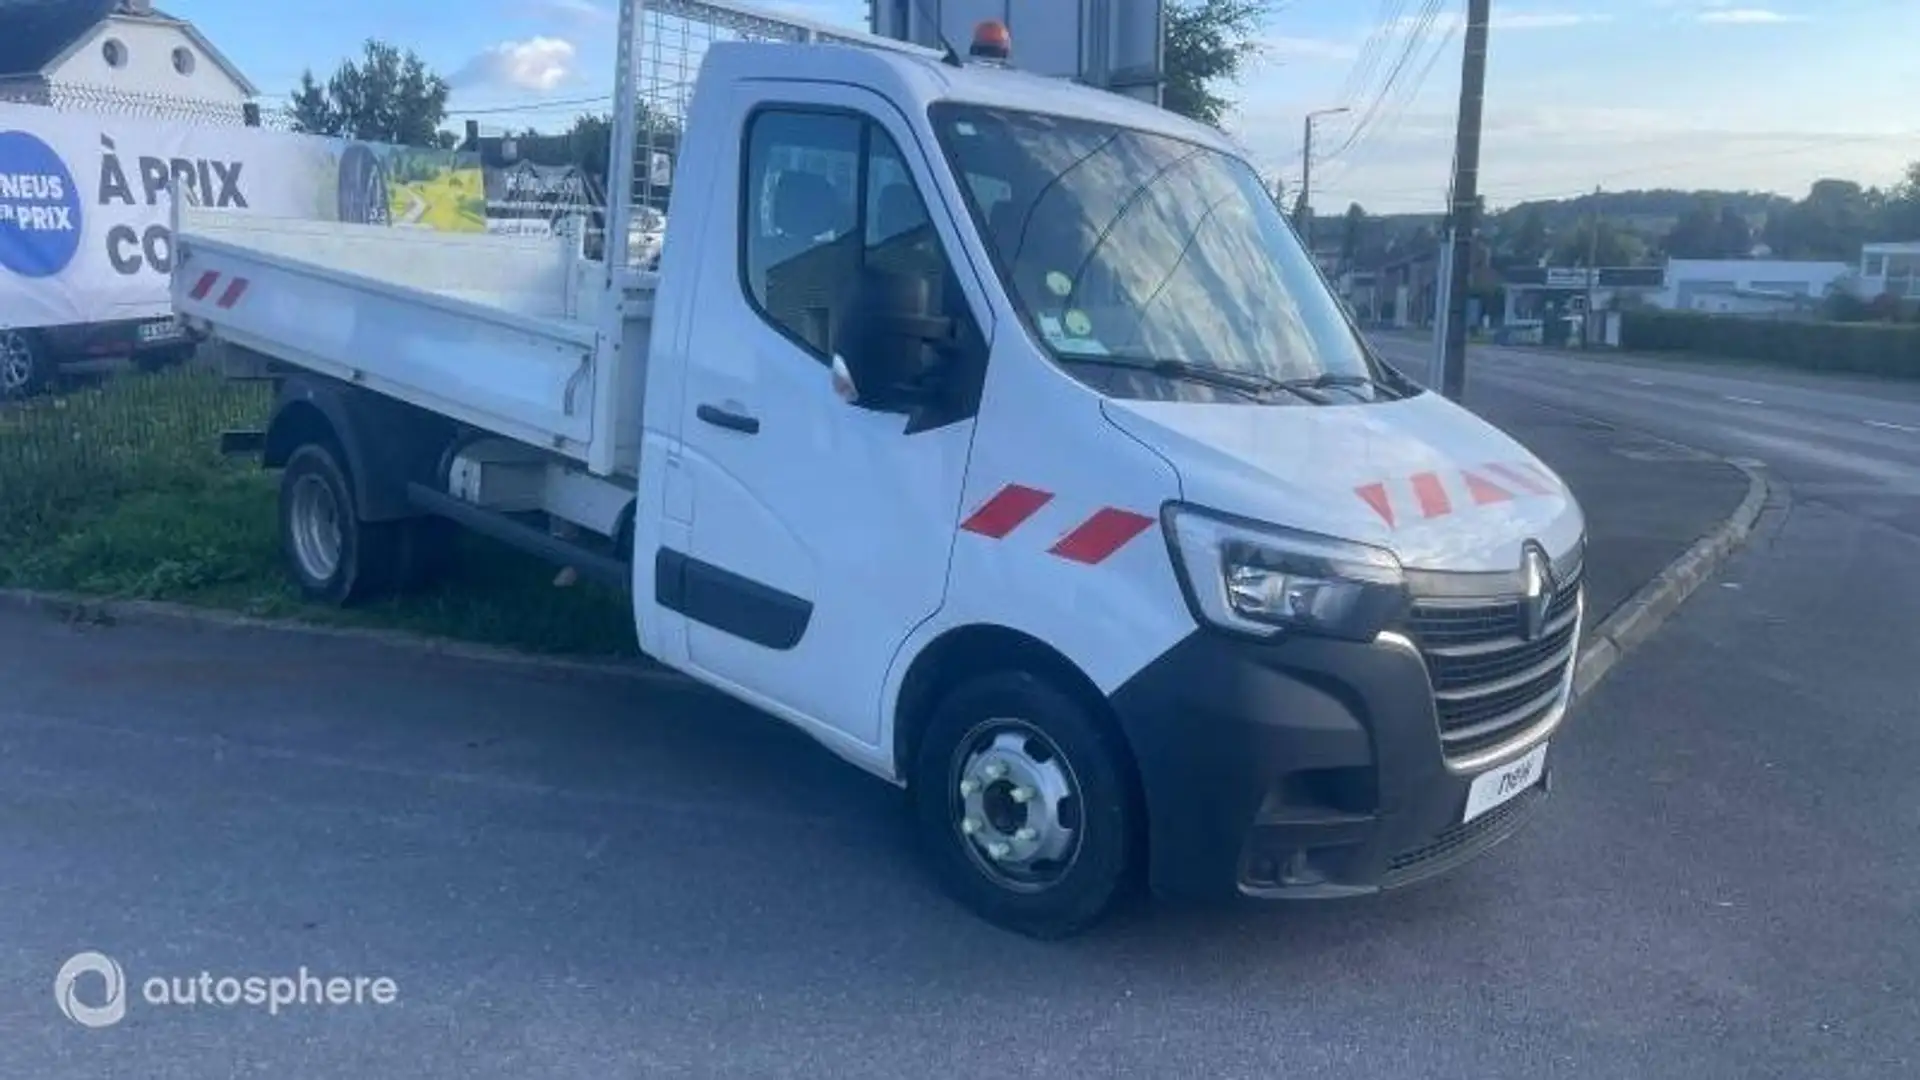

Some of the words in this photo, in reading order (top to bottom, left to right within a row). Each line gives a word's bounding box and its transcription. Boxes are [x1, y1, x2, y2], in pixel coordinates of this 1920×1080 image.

[98, 132, 136, 205] À
[139, 156, 248, 208] PRIX
[17, 206, 74, 230] PRIX
[106, 224, 172, 275] CO
